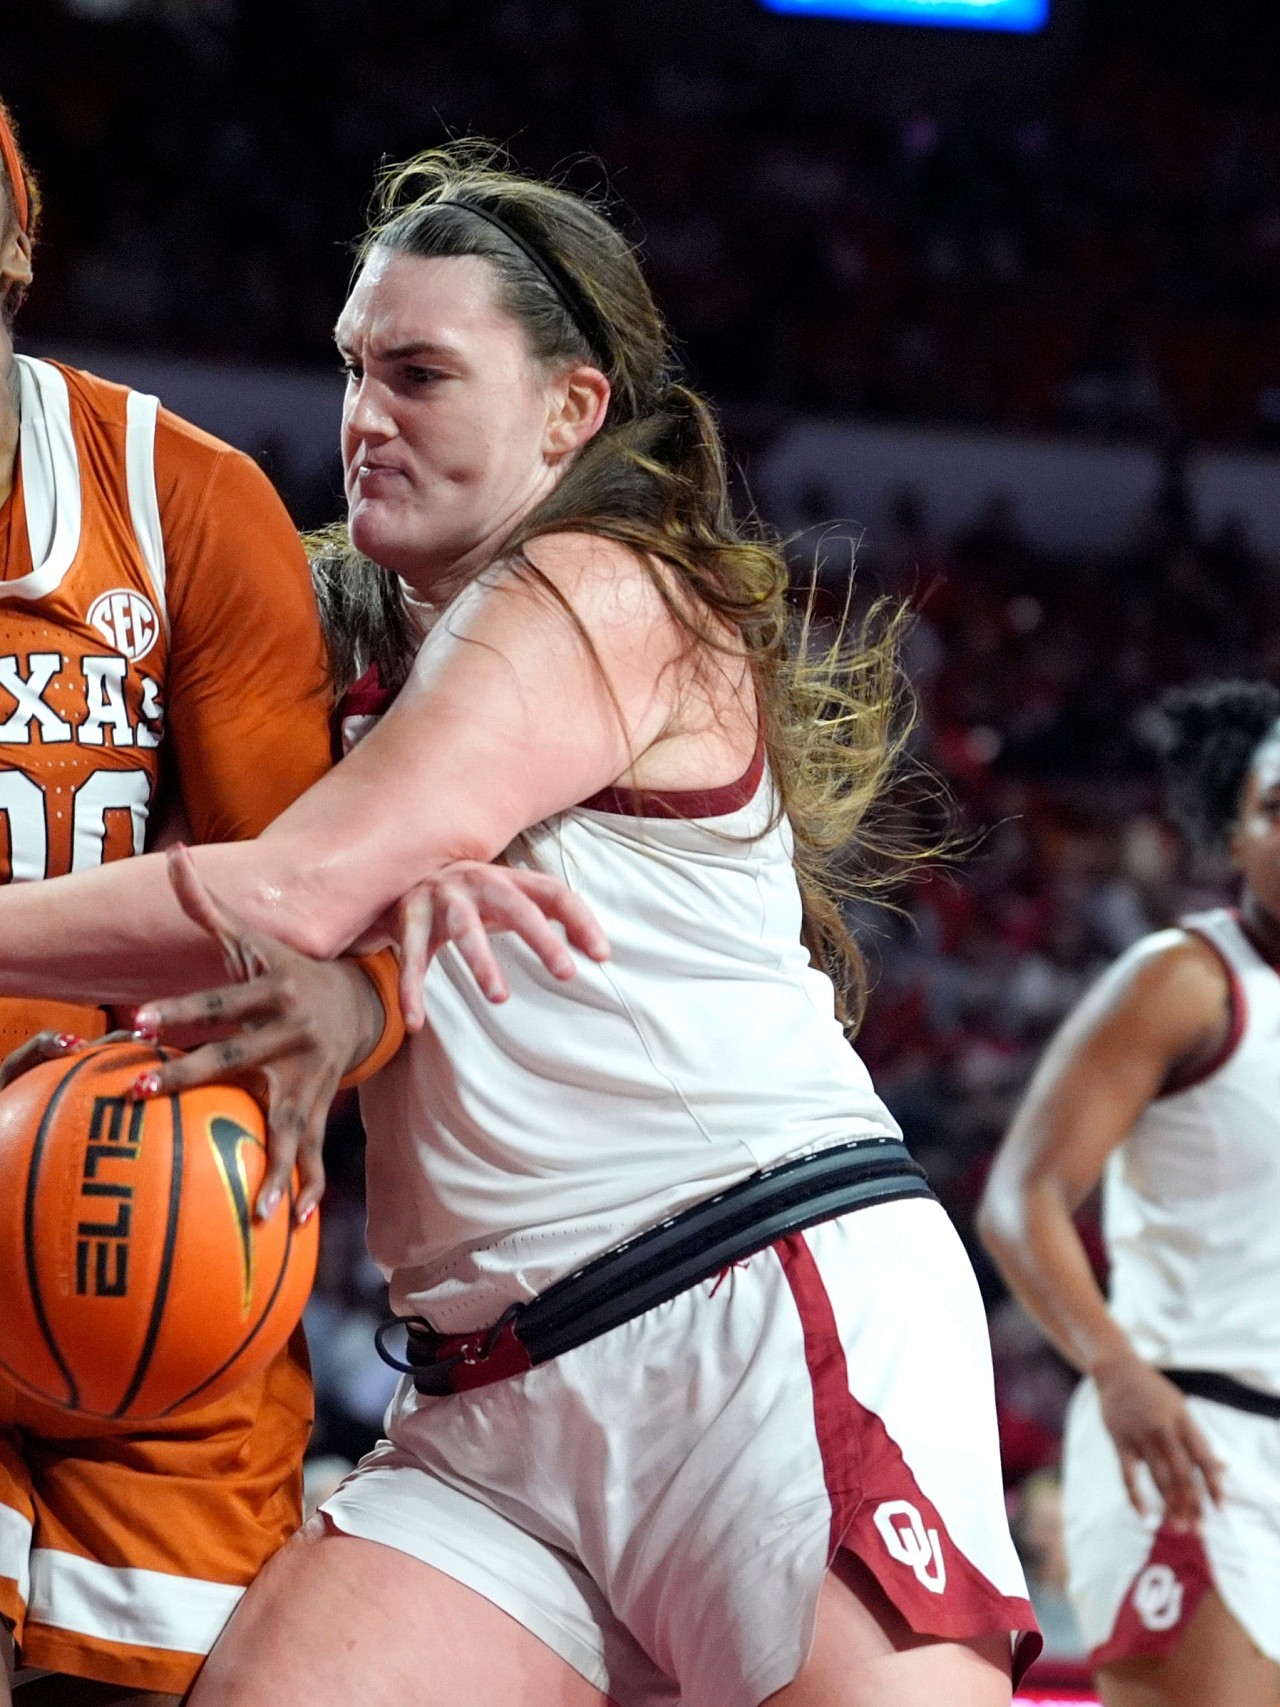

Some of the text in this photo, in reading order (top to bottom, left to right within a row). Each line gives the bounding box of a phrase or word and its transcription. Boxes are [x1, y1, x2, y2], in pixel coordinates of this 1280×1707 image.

[89, 590, 157, 661] SEC
[75, 1095, 146, 1298] ELITE
[872, 1498, 947, 1595] OU
